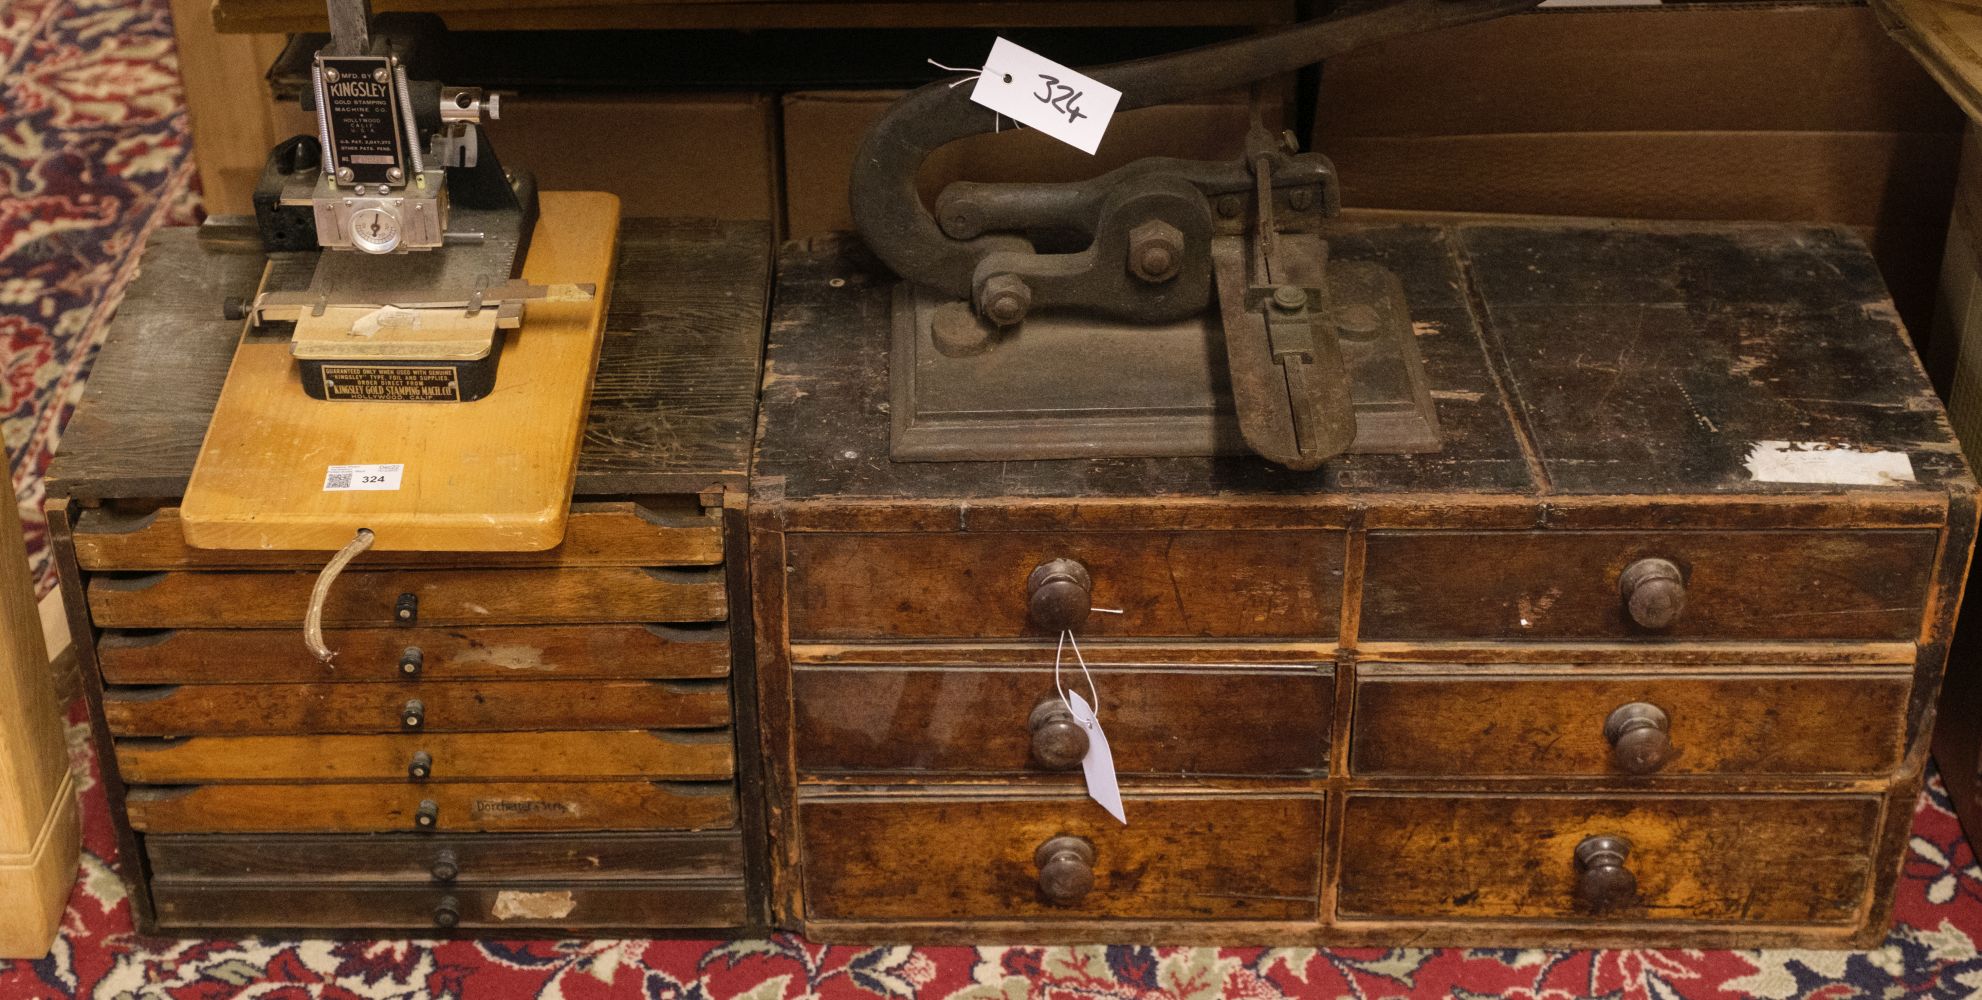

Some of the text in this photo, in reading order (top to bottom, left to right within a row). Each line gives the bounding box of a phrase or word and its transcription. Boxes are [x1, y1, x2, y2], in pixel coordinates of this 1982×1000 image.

[331, 82, 386, 97] KINGSLEY
[1033, 74, 1088, 124] 324
[334, 385, 363, 394] KINGSLEY
[366, 386, 384, 394] GOLD
[386, 386, 420, 395] STAMPING
